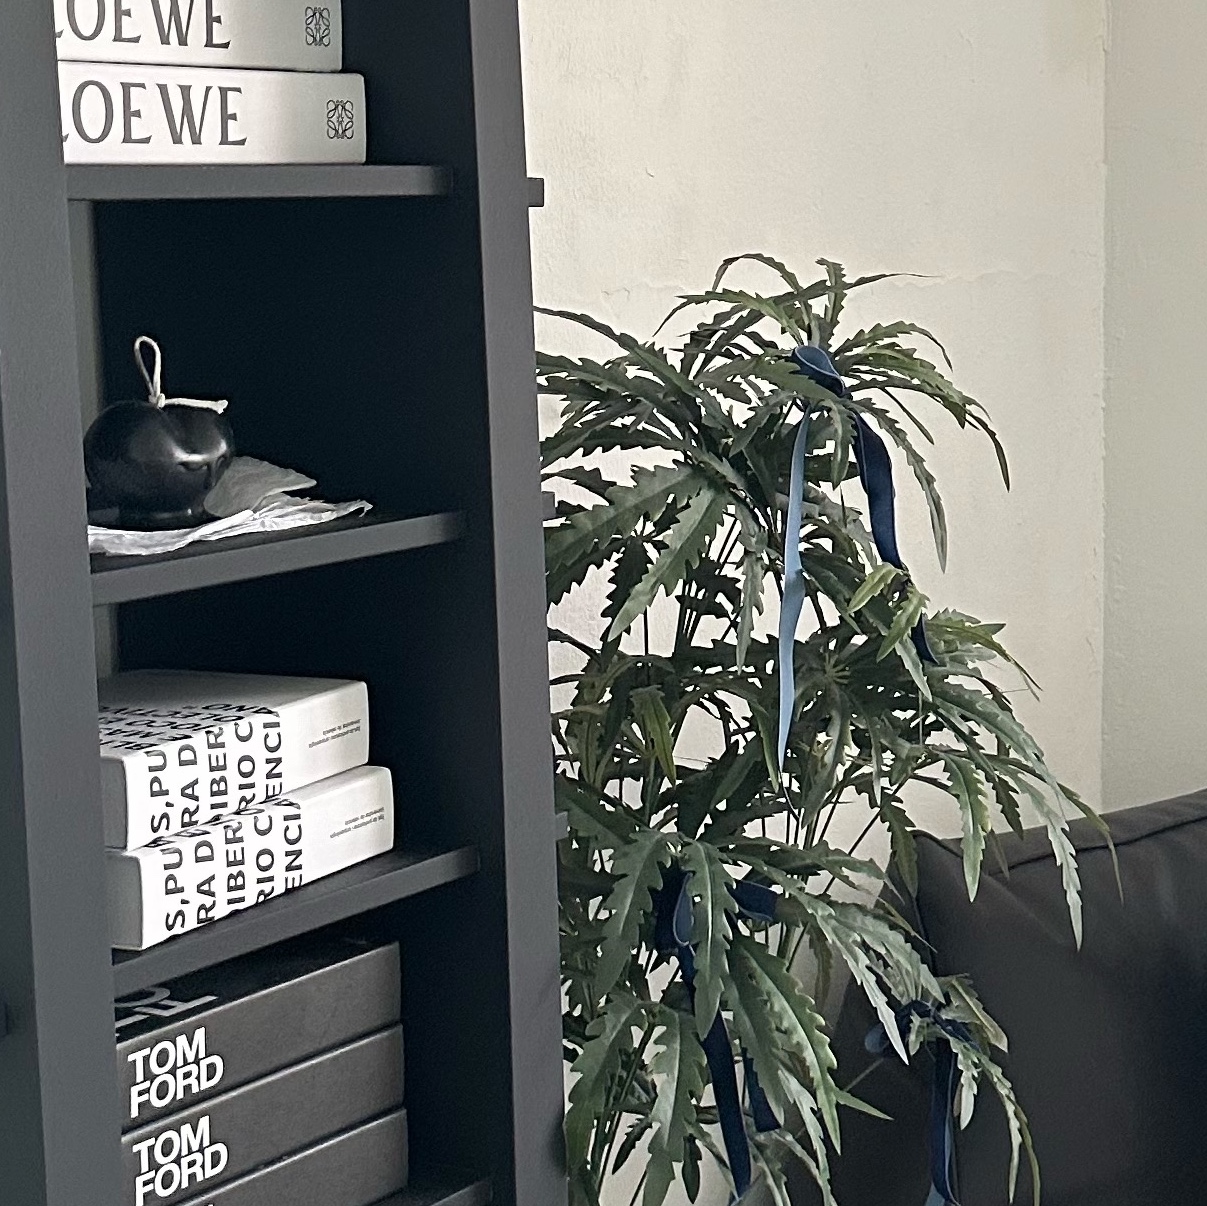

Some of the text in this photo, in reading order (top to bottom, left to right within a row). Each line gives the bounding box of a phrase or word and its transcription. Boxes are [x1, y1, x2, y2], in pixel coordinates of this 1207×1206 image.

[56, 0, 231, 49] OEWE
[62, 79, 248, 146] OEWE
[127, 1026, 206, 1084] TOM
[130, 1054, 224, 1119] FORD
[132, 1115, 210, 1174] TOM
